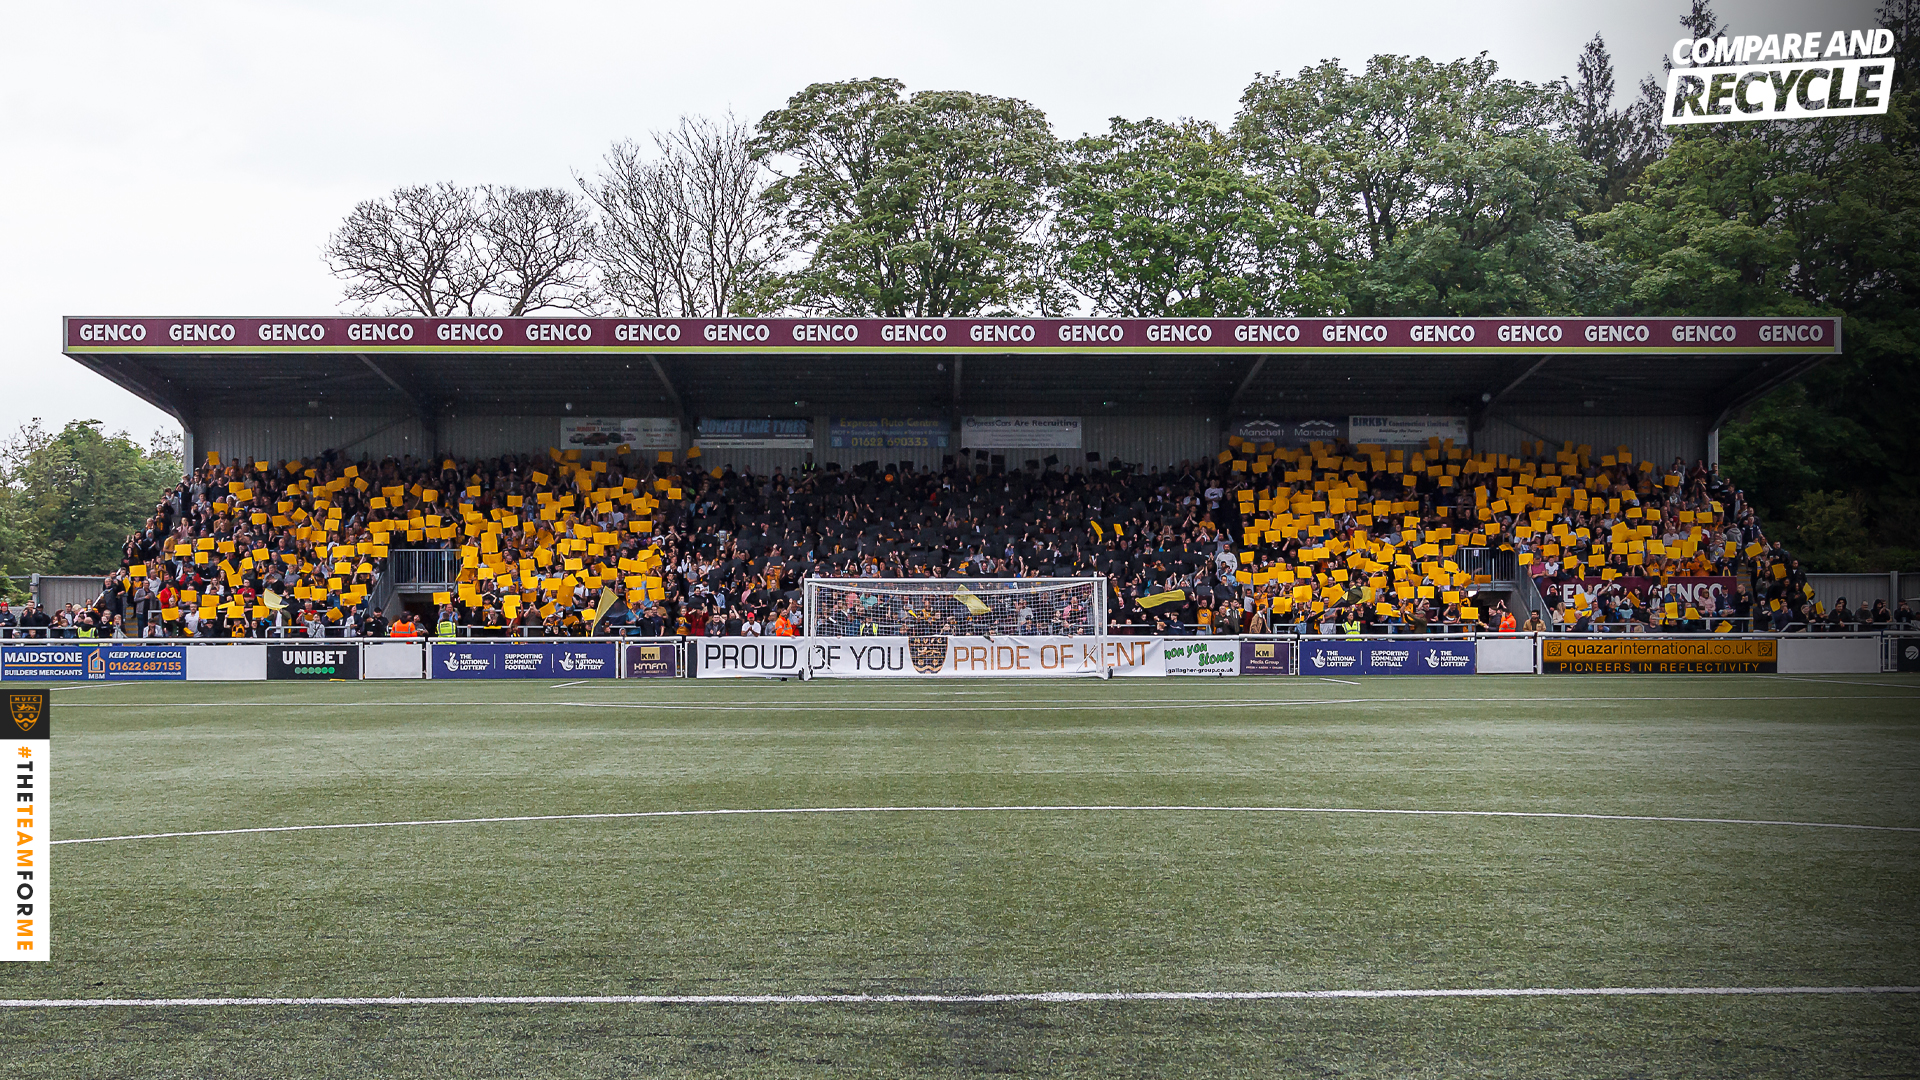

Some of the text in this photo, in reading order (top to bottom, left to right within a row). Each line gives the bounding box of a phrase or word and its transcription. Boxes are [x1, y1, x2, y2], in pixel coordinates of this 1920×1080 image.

[80, 324, 1823, 341] GENCO GENCO GENCO GENCO GENCO GENCO GENCO GENCO GENCO GENCO GENCO GENCO GENCO GENCO GENCO GENCO GENCO GENCO GENCO GENCO
[773, 419, 807, 433] TYRES
[840, 418, 877, 428] Express
[881, 418, 903, 427] Auto
[1014, 419, 1029, 427] Are
[1032, 419, 1078, 428] Recruiting
[1353, 417, 1388, 427] BIRKBY
[1294, 428, 1339, 437] Manchett
[851, 437, 929, 447] 01622 690333
[1566, 642, 1752, 657] quazarinternational.co.uk
[4, 652, 83, 663] MAIDSTONE
[108, 651, 182, 659] KEEP TRADE LOCAL
[282, 650, 347, 665] UNIBET
[705, 644, 904, 670] PROUD OF YOU
[954, 641, 1151, 671] PRIDE OF KENT
[109, 661, 181, 671] 01622 687155
[1560, 663, 1759, 672] PIONEERS IN REFLECTIVITY
